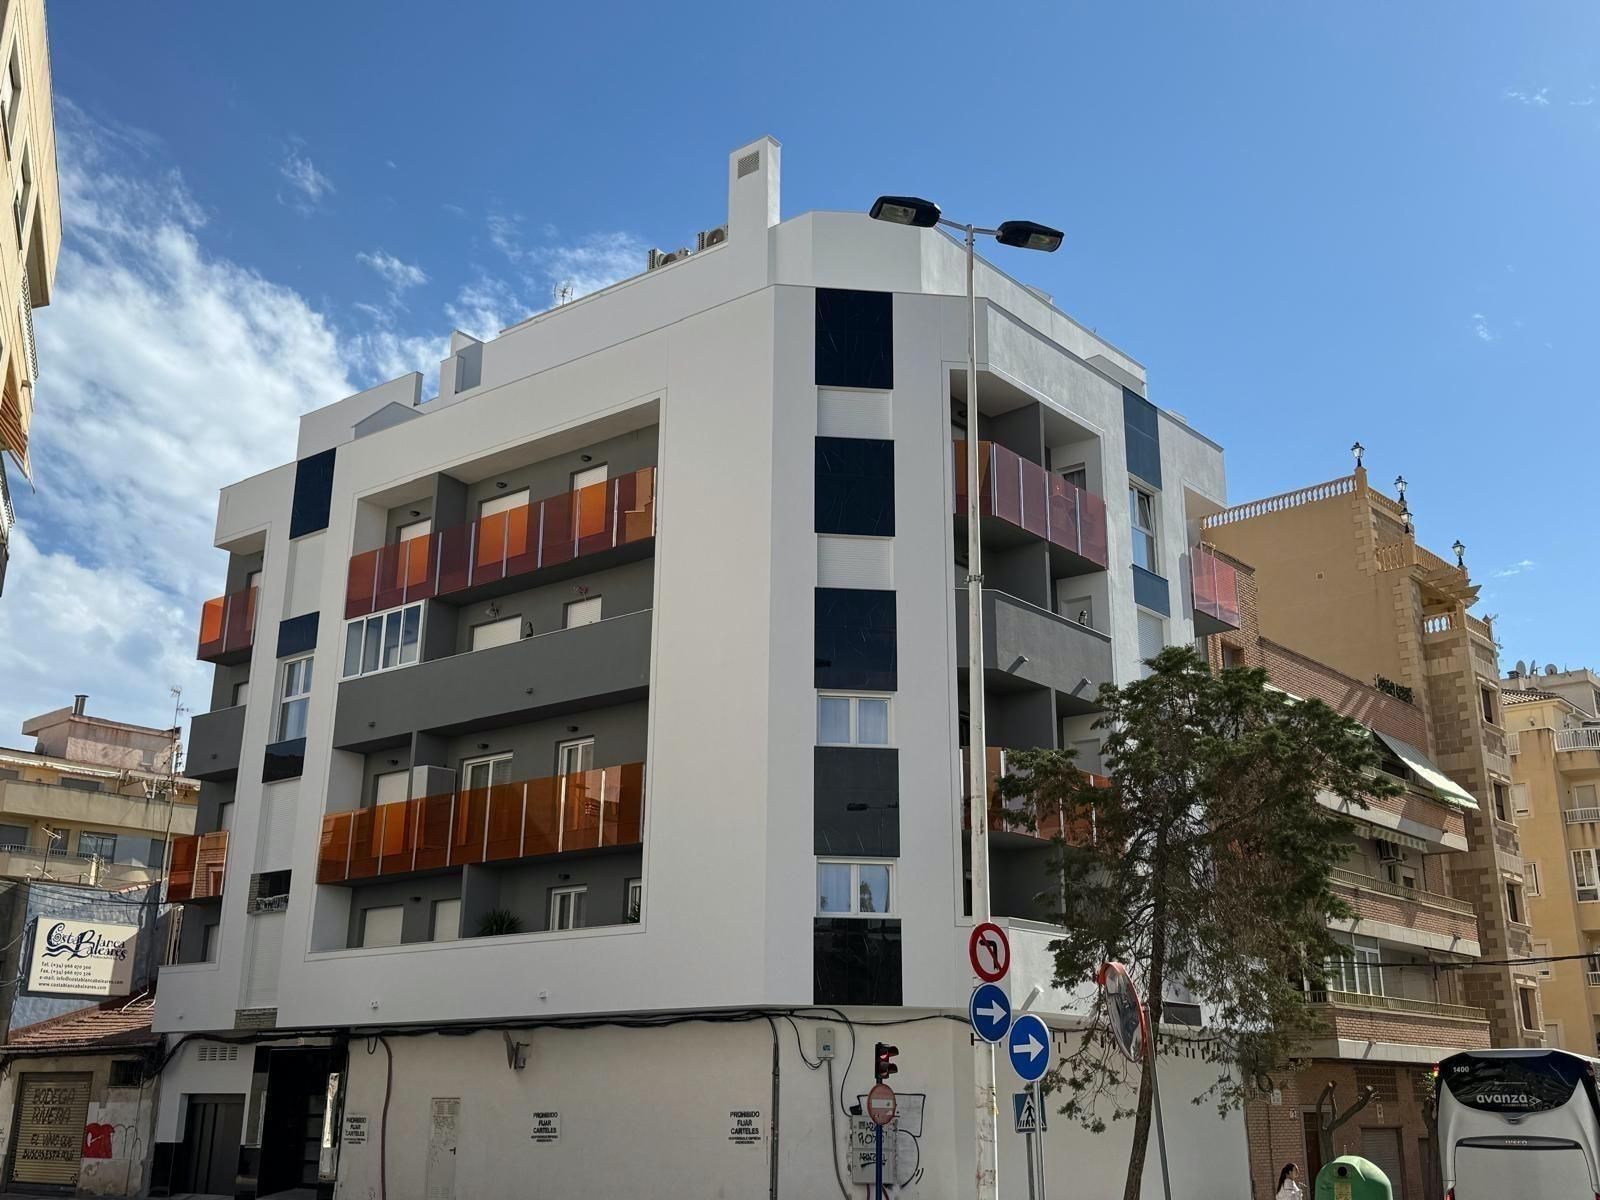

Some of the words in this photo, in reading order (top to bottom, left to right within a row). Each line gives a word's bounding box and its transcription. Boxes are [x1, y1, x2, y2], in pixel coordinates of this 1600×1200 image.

[47, 922, 77, 947] Costa
[31, 1087, 76, 1105] BODEGA
[1477, 1094, 1528, 1103] avanza
[736, 1119, 753, 1127] FIJAR
[730, 1127, 759, 1135] CARTELES
